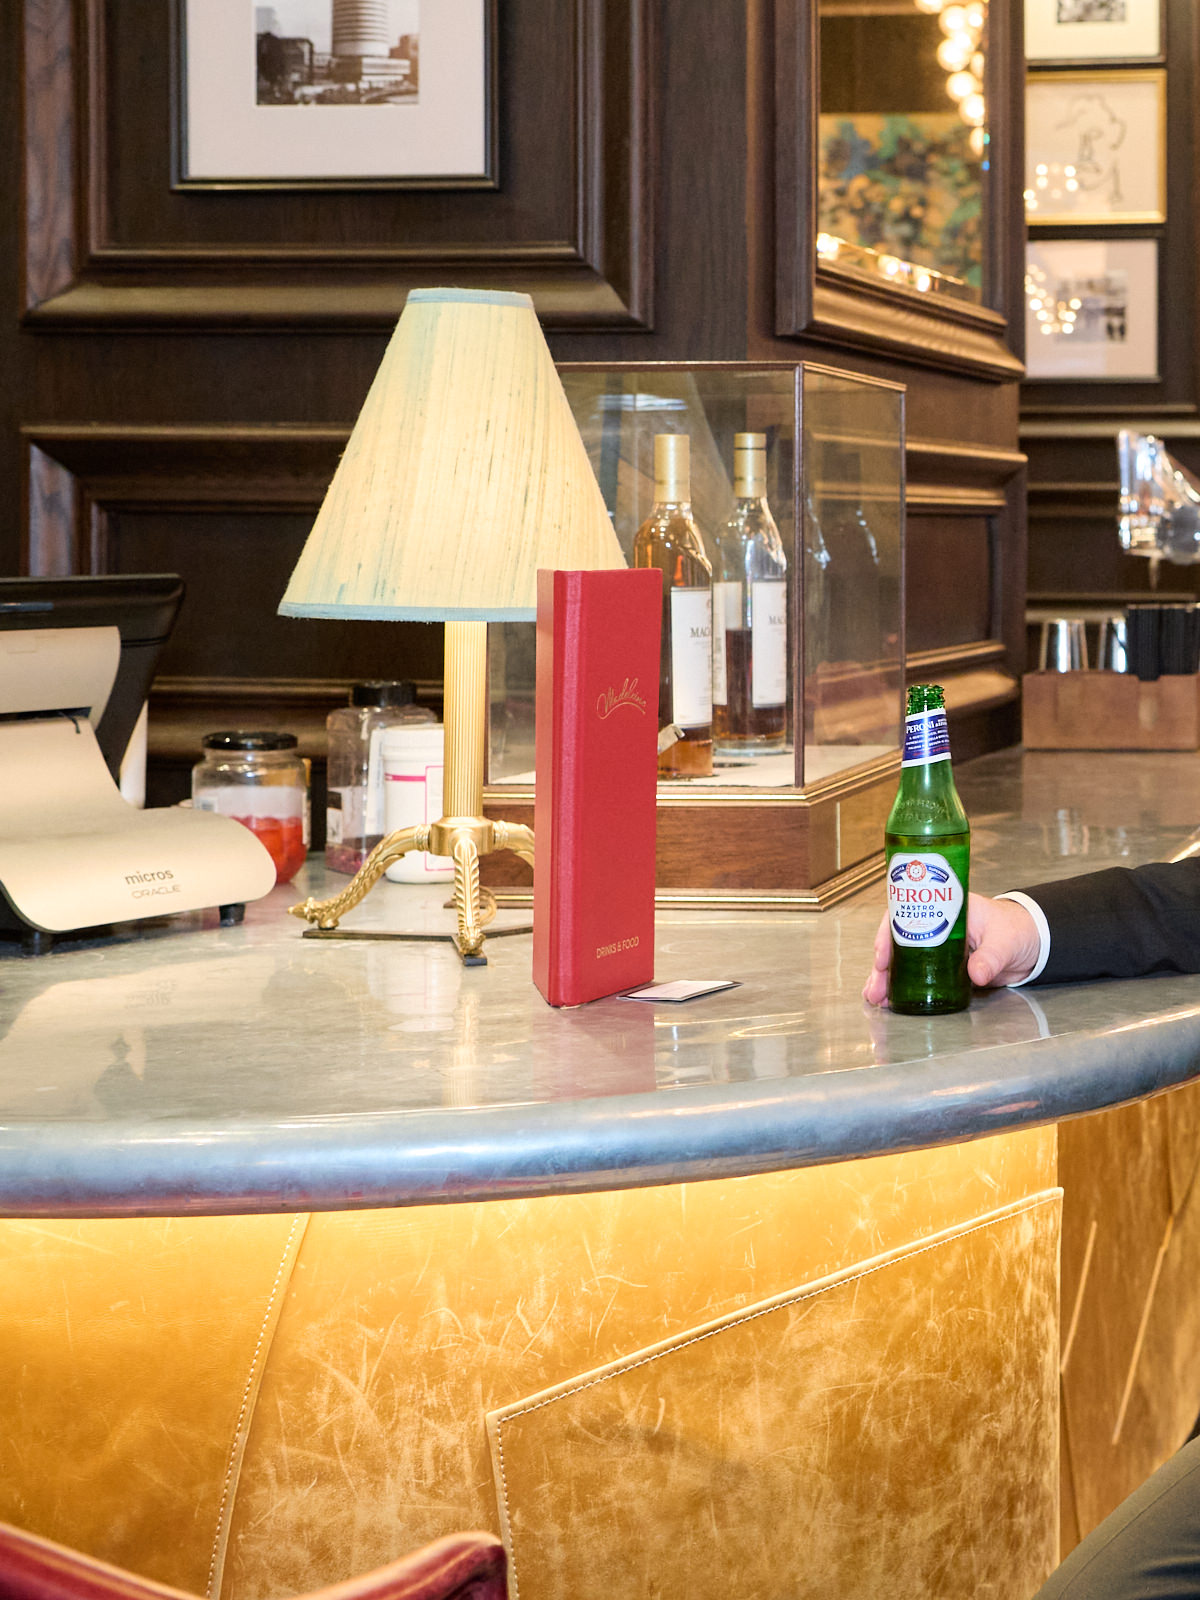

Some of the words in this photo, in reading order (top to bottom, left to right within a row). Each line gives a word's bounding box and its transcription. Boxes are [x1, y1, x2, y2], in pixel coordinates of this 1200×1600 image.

[905, 720, 935, 734] PERONI
[124, 869, 174, 885] micros
[131, 884, 182, 899] ORACLE
[889, 884, 953, 904] PERONI
[895, 910, 944, 919] AZZURRO
[901, 930, 935, 940] ITALIANA
[596, 943, 616, 959] DRINKS
[622, 936, 640, 950] FOOD
